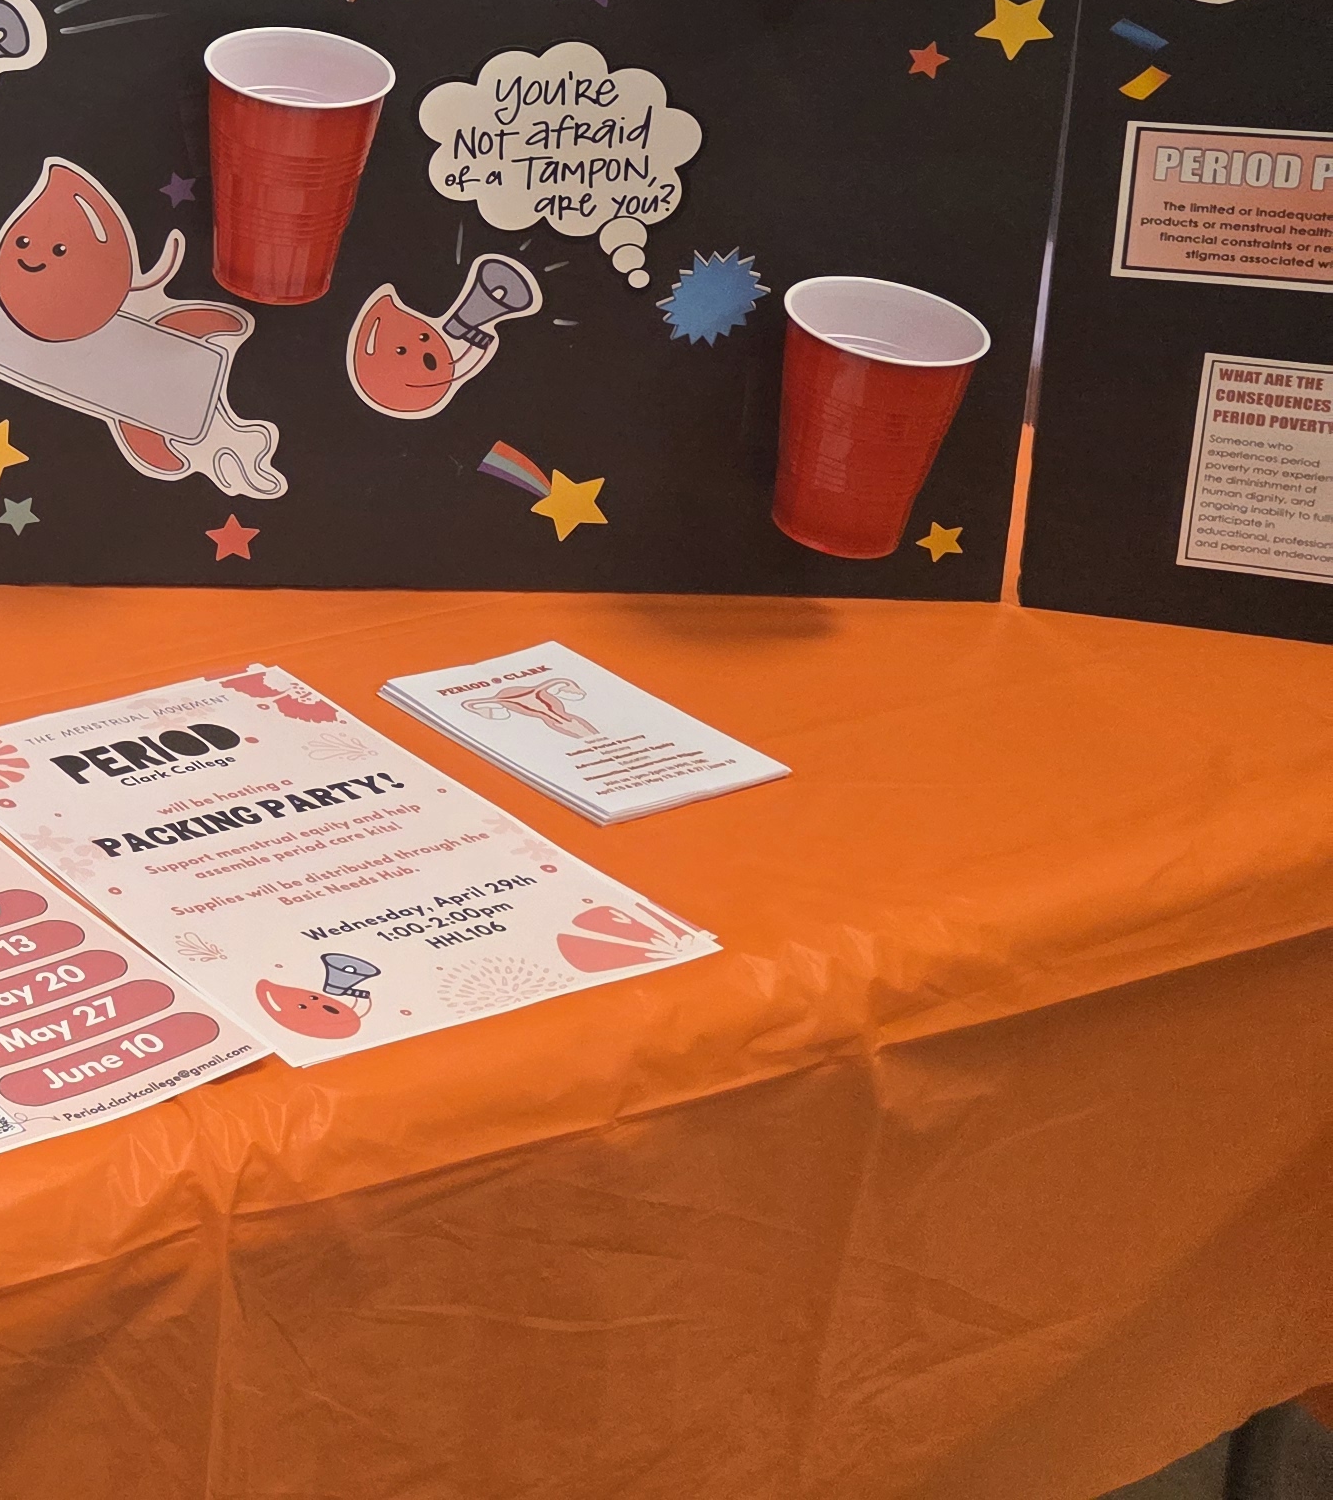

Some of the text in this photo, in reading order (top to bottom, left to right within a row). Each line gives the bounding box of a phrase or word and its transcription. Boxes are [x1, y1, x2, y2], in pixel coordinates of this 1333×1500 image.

[444, 166, 481, 192] of
[485, 170, 503, 186] a
[1153, 146, 1301, 190] PERIOD
[611, 184, 675, 219] you?
[1219, 368, 1323, 391] WHAT ARE THE
[1215, 388, 1331, 412] CONSEQUENCES
[1213, 409, 1265, 428] PERIOD
[50, 723, 259, 784] PERIOD.
[120, 755, 237, 787] Clark College
[92, 772, 405, 857] PACKING PARTY!
[300, 875, 538, 941] Wednesday, April 29th
[376, 901, 514, 942] 1:00-2:00pm
[425, 921, 507, 950] HHL106
[35, 964, 85, 992] 20
[72, 996, 117, 1027] 27
[42, 1033, 164, 1089] June 10
